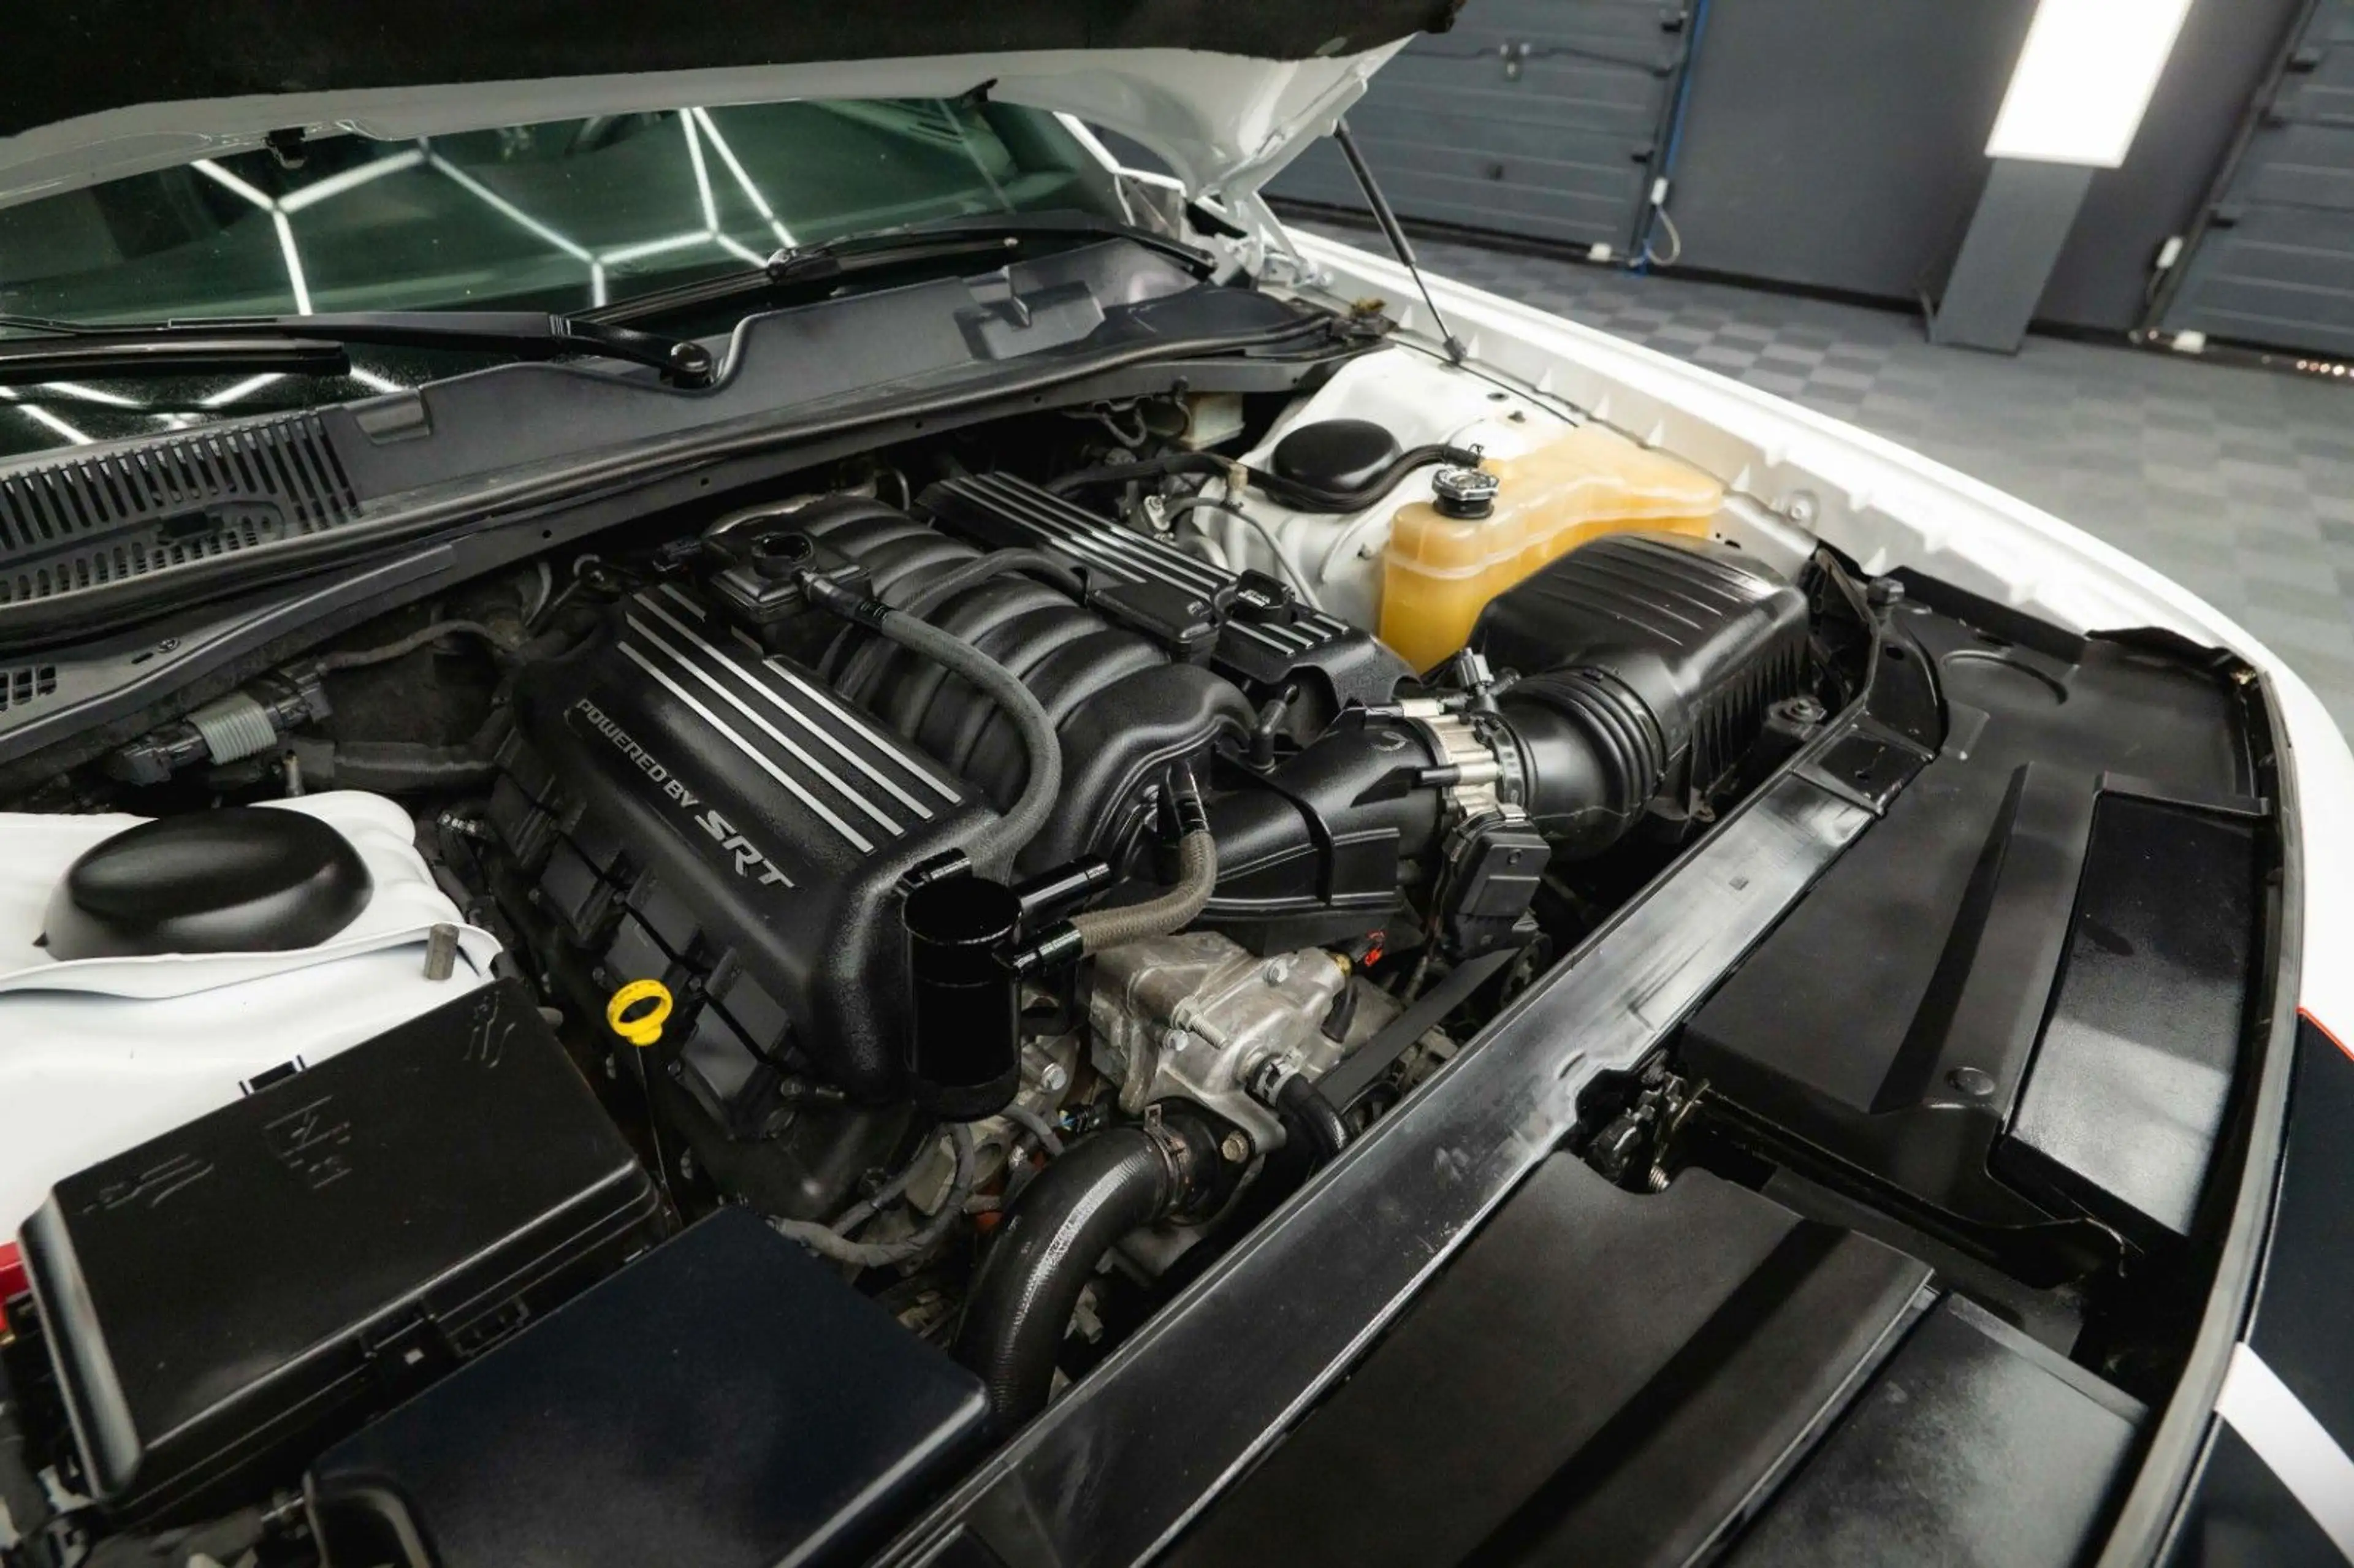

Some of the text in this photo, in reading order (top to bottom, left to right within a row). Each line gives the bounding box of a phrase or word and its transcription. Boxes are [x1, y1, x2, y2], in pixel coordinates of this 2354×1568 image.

[575, 698, 796, 888] POWERED BY SRT
